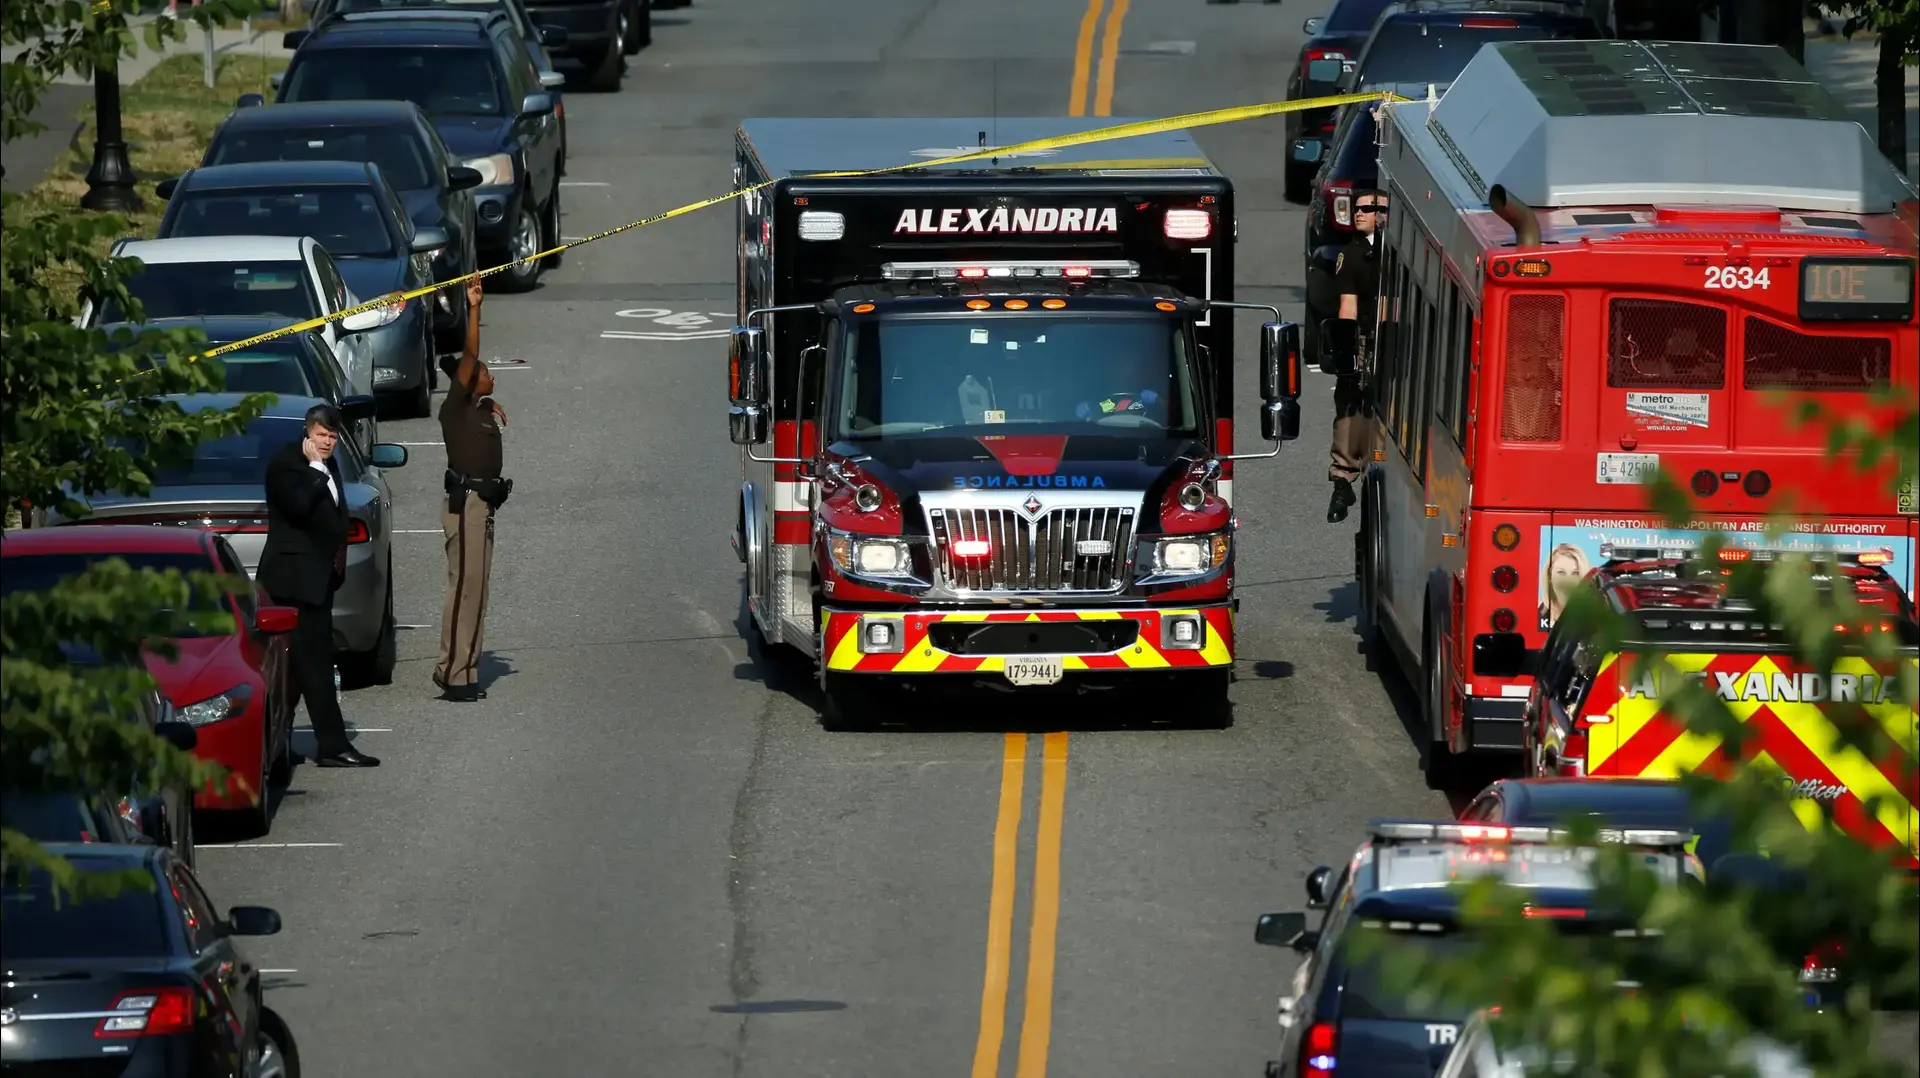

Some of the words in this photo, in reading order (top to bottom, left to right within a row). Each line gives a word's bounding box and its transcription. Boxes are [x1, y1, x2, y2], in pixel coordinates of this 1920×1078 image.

[893, 207, 1118, 234] ALEXANDRIA
[1704, 266, 1770, 290] 2634
[1811, 266, 1867, 300] 10E
[1575, 519, 1648, 529] WASHINGTON
[1651, 520, 1737, 531] MEOPOLITAN
[1740, 522, 1770, 532] AREA
[1823, 524, 1886, 534] AUTHORITY
